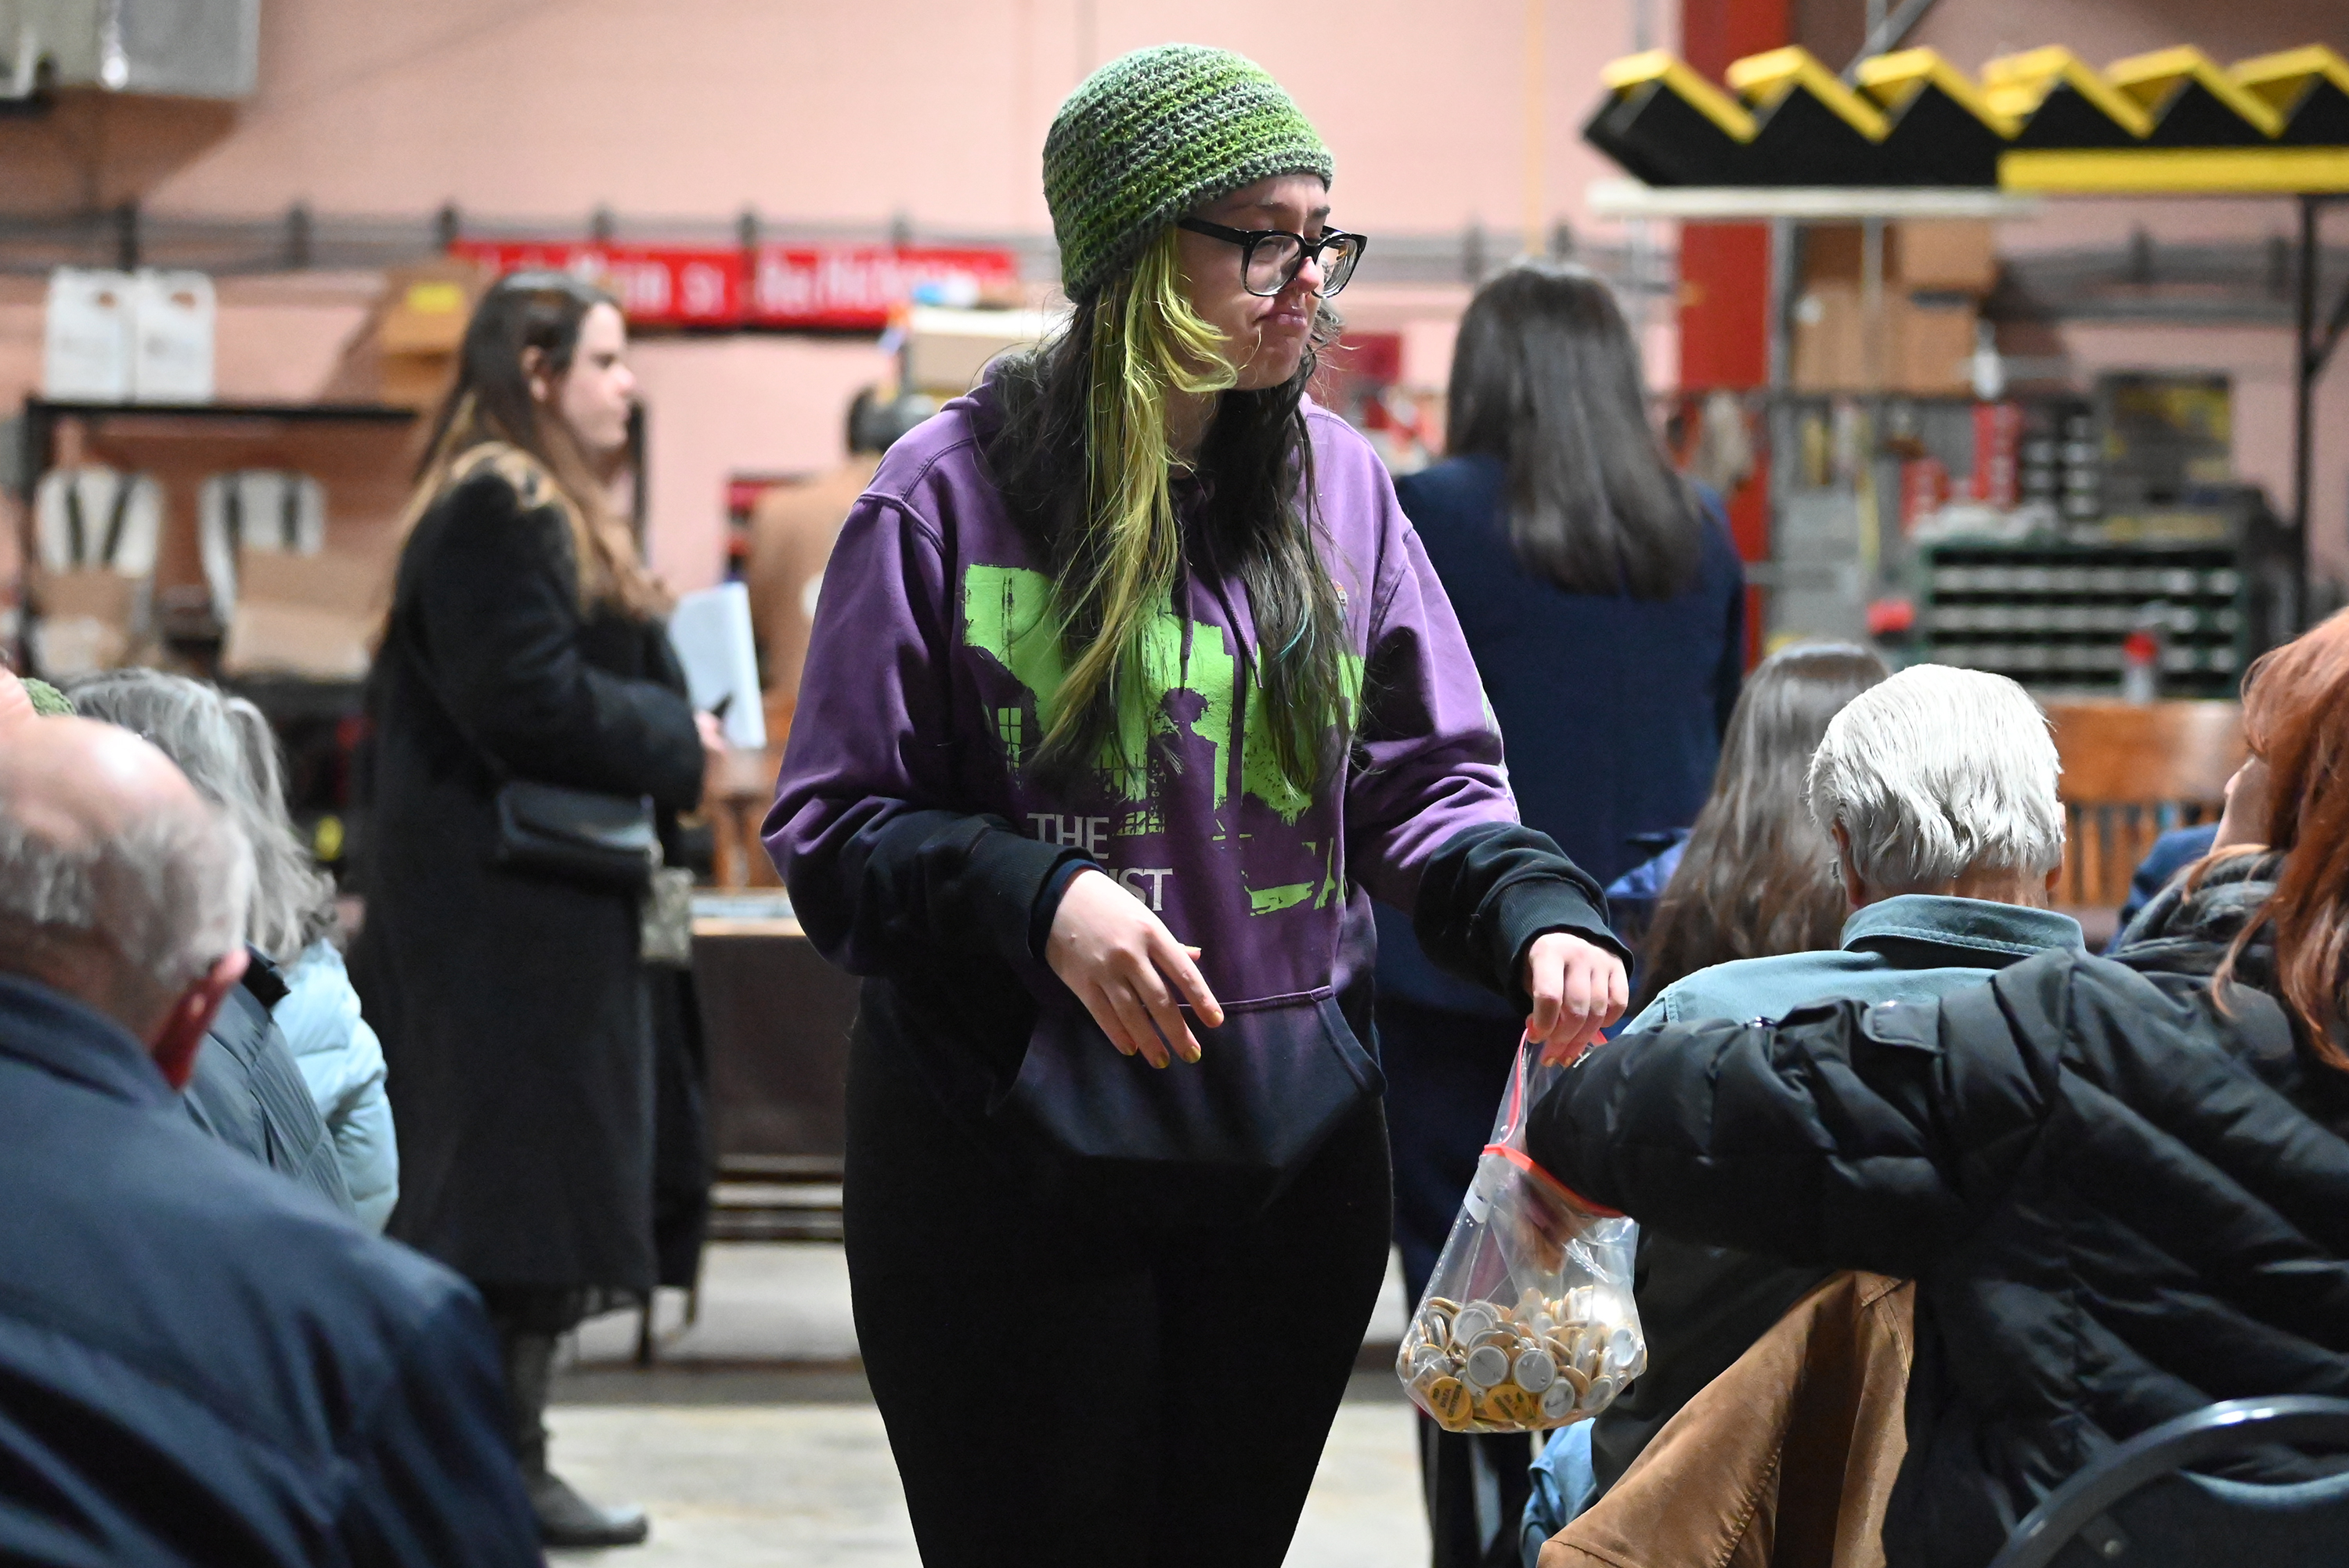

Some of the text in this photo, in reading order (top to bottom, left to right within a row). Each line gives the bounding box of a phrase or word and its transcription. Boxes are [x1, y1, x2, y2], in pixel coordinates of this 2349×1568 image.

[1027, 813, 1109, 860] THE
[1432, 1388, 1440, 1400] NO
[1440, 1389, 1452, 1408] DATA
